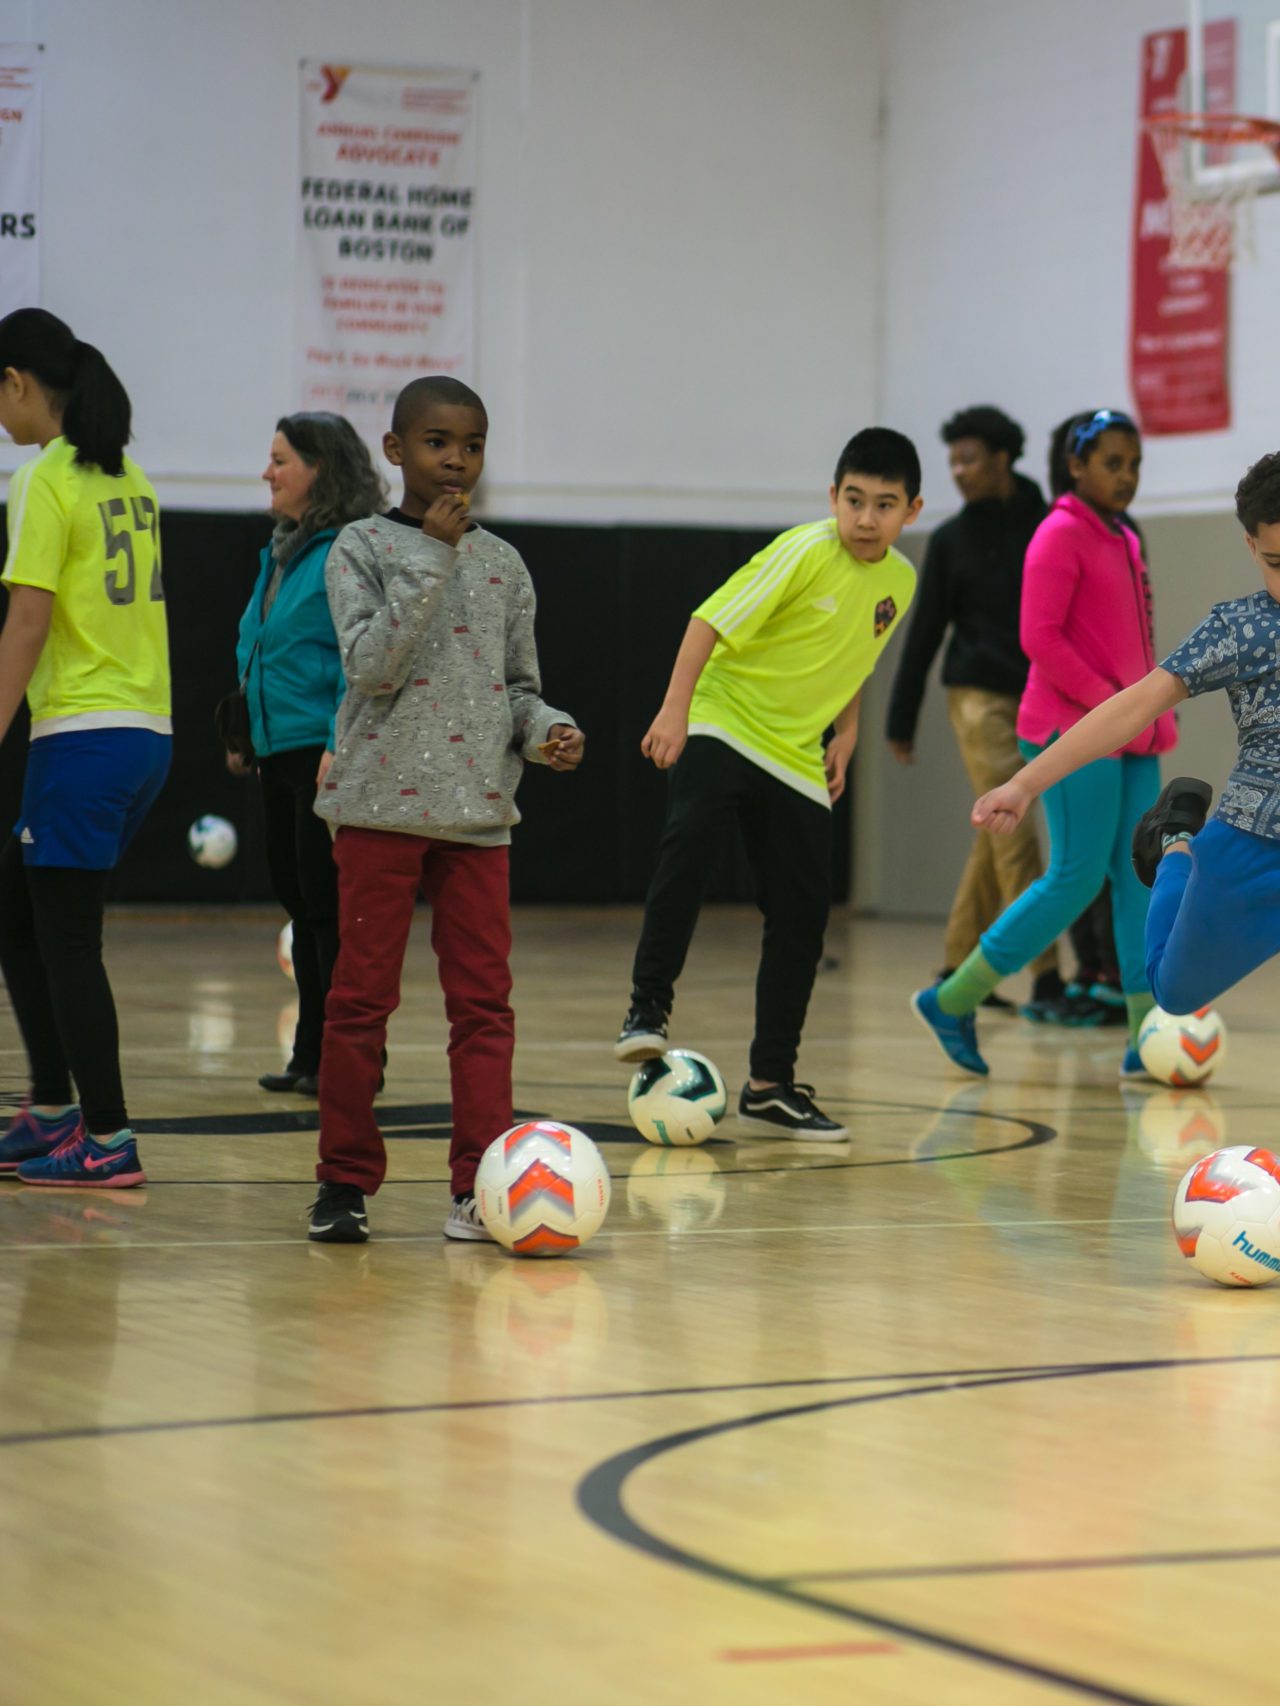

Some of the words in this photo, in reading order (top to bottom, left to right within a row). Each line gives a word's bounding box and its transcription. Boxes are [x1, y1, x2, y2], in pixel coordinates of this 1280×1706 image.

[336, 143, 439, 168] ADVOCATE
[301, 176, 399, 204] FEDERAL
[408, 186, 473, 208] HOME
[0, 213, 36, 238] RS
[303, 205, 365, 230] LOAN
[372, 208, 433, 235] BANK
[440, 213, 470, 238] OF
[338, 236, 433, 263] BOSTON
